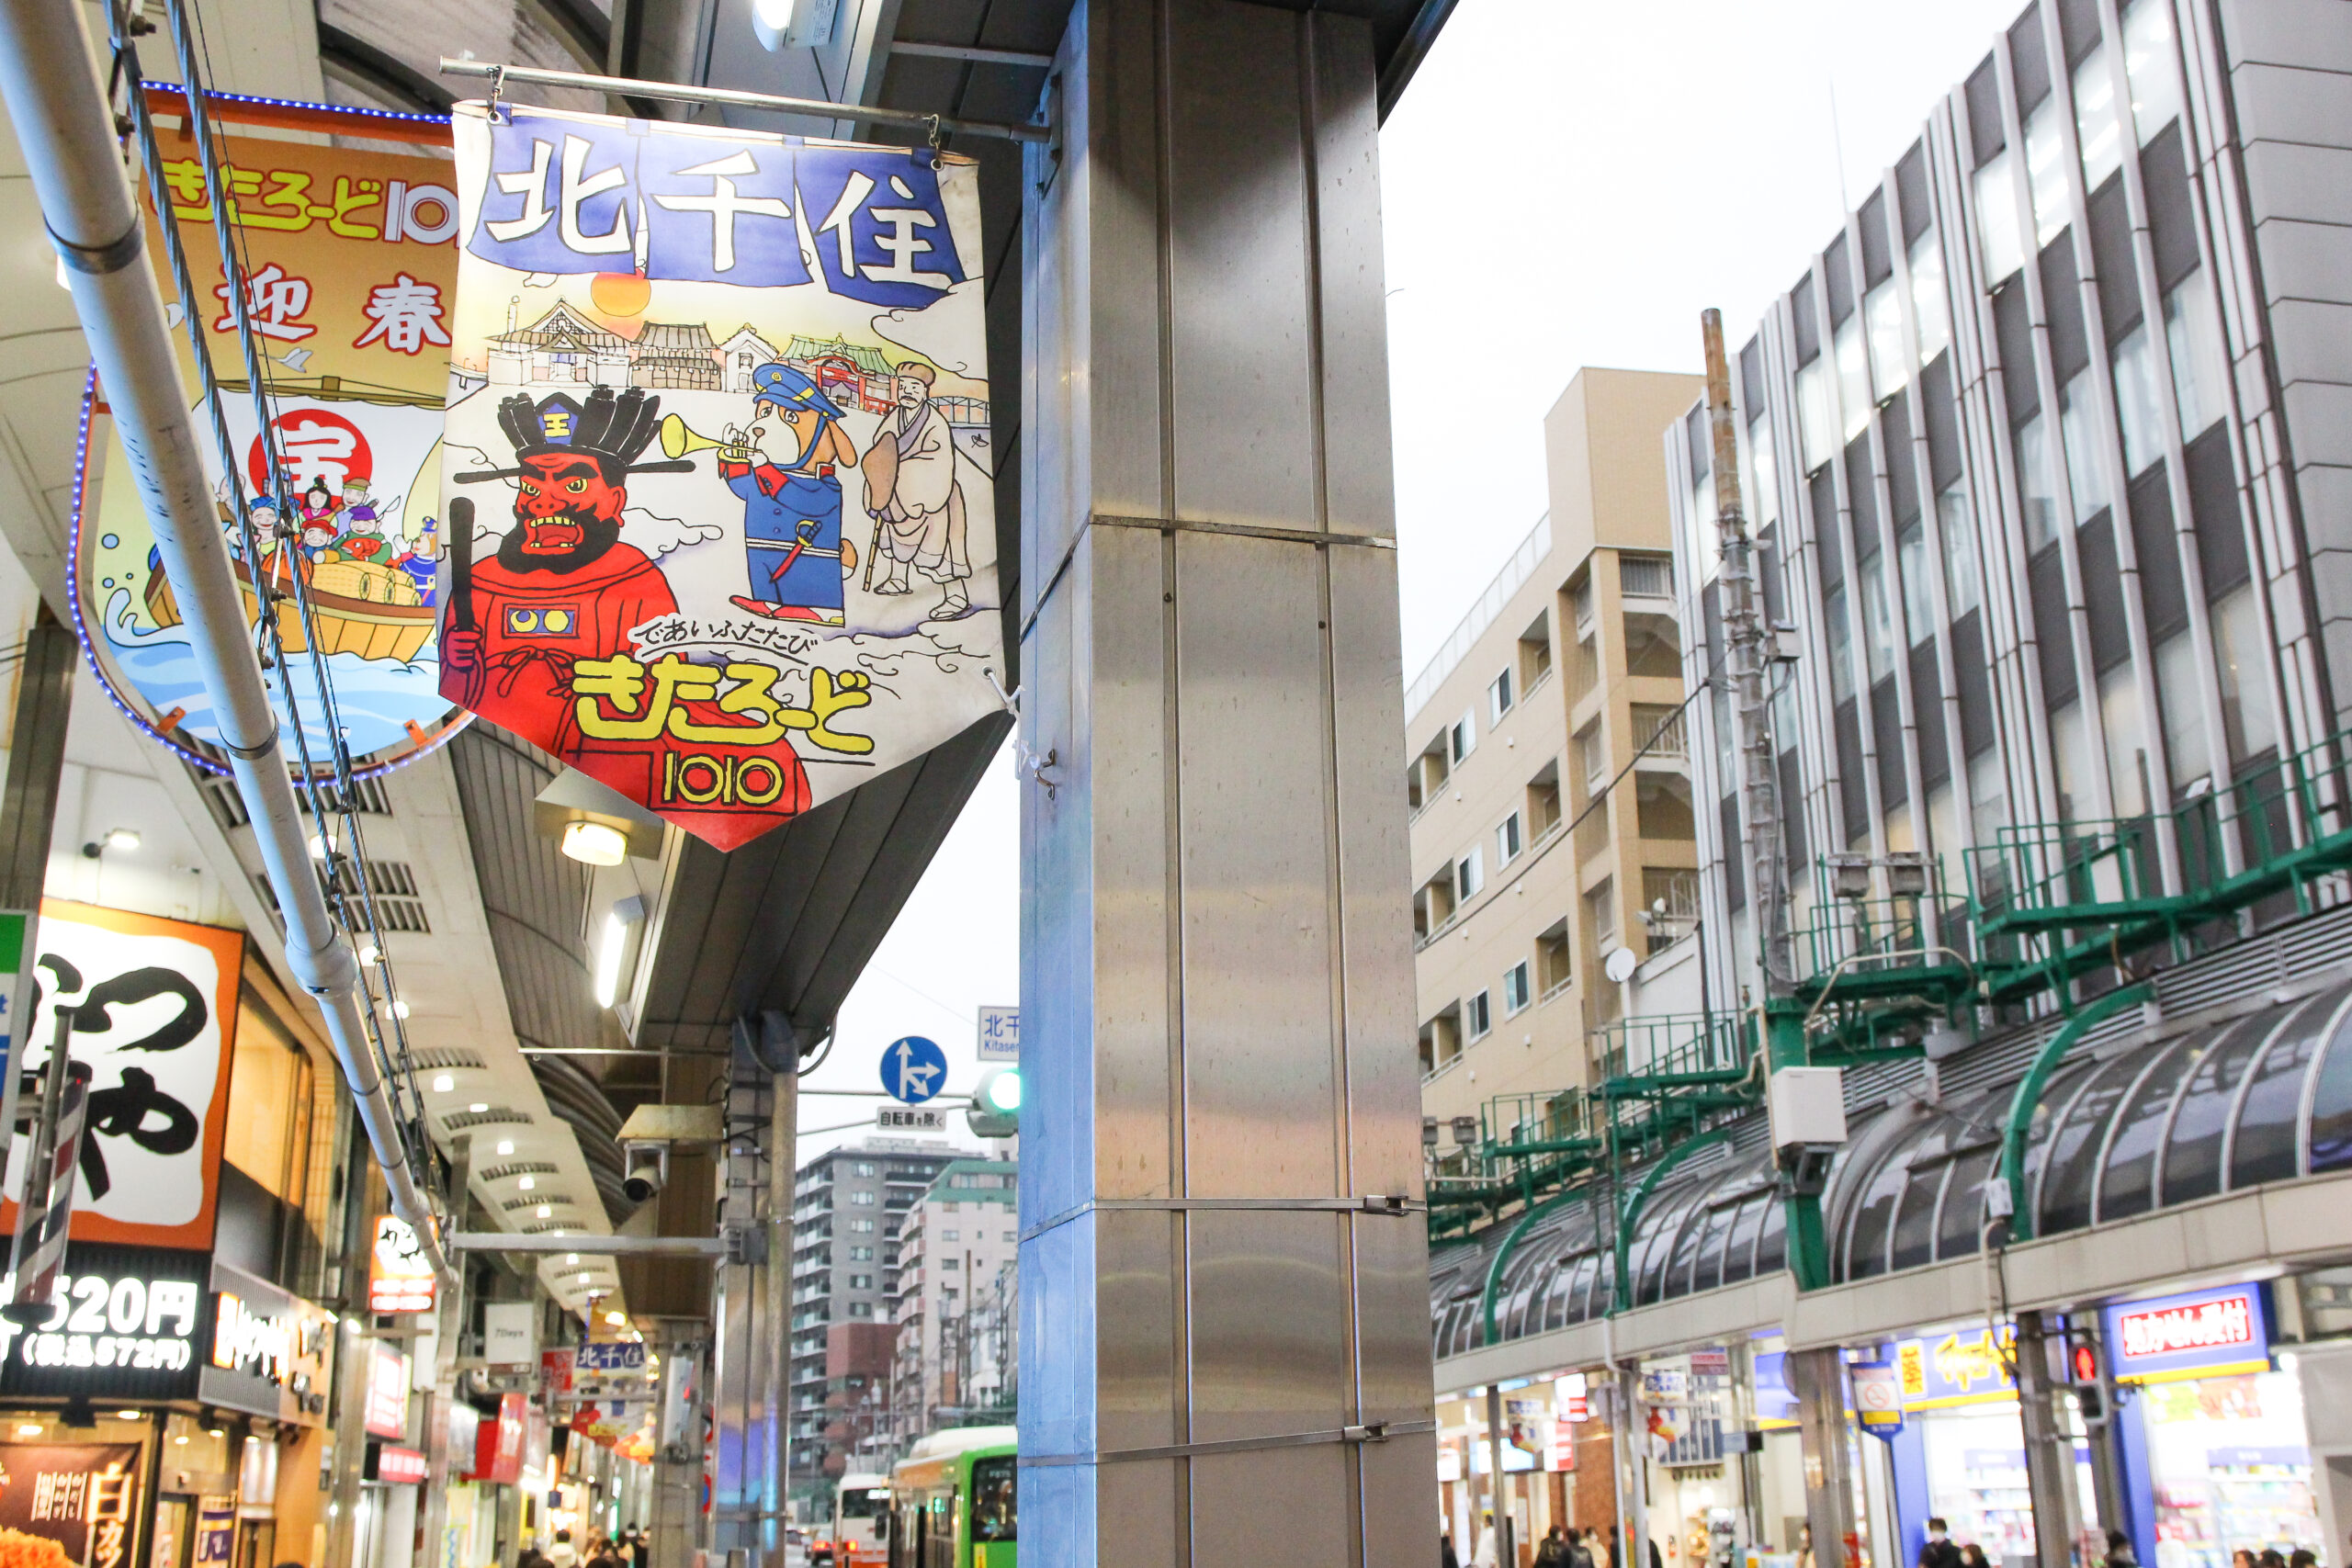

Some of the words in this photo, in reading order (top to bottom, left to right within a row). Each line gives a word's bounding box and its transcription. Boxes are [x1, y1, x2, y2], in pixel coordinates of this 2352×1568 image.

[150, 158, 459, 248] きたろーど10
[484, 131, 956, 292] 北千住
[634, 618, 819, 655] であいふたたび
[572, 653, 876, 755] きたろーど
[662, 750, 785, 806] 1010
[879, 1111, 944, 1128] 自転車を除く
[578, 1345, 645, 1369] 北千住
